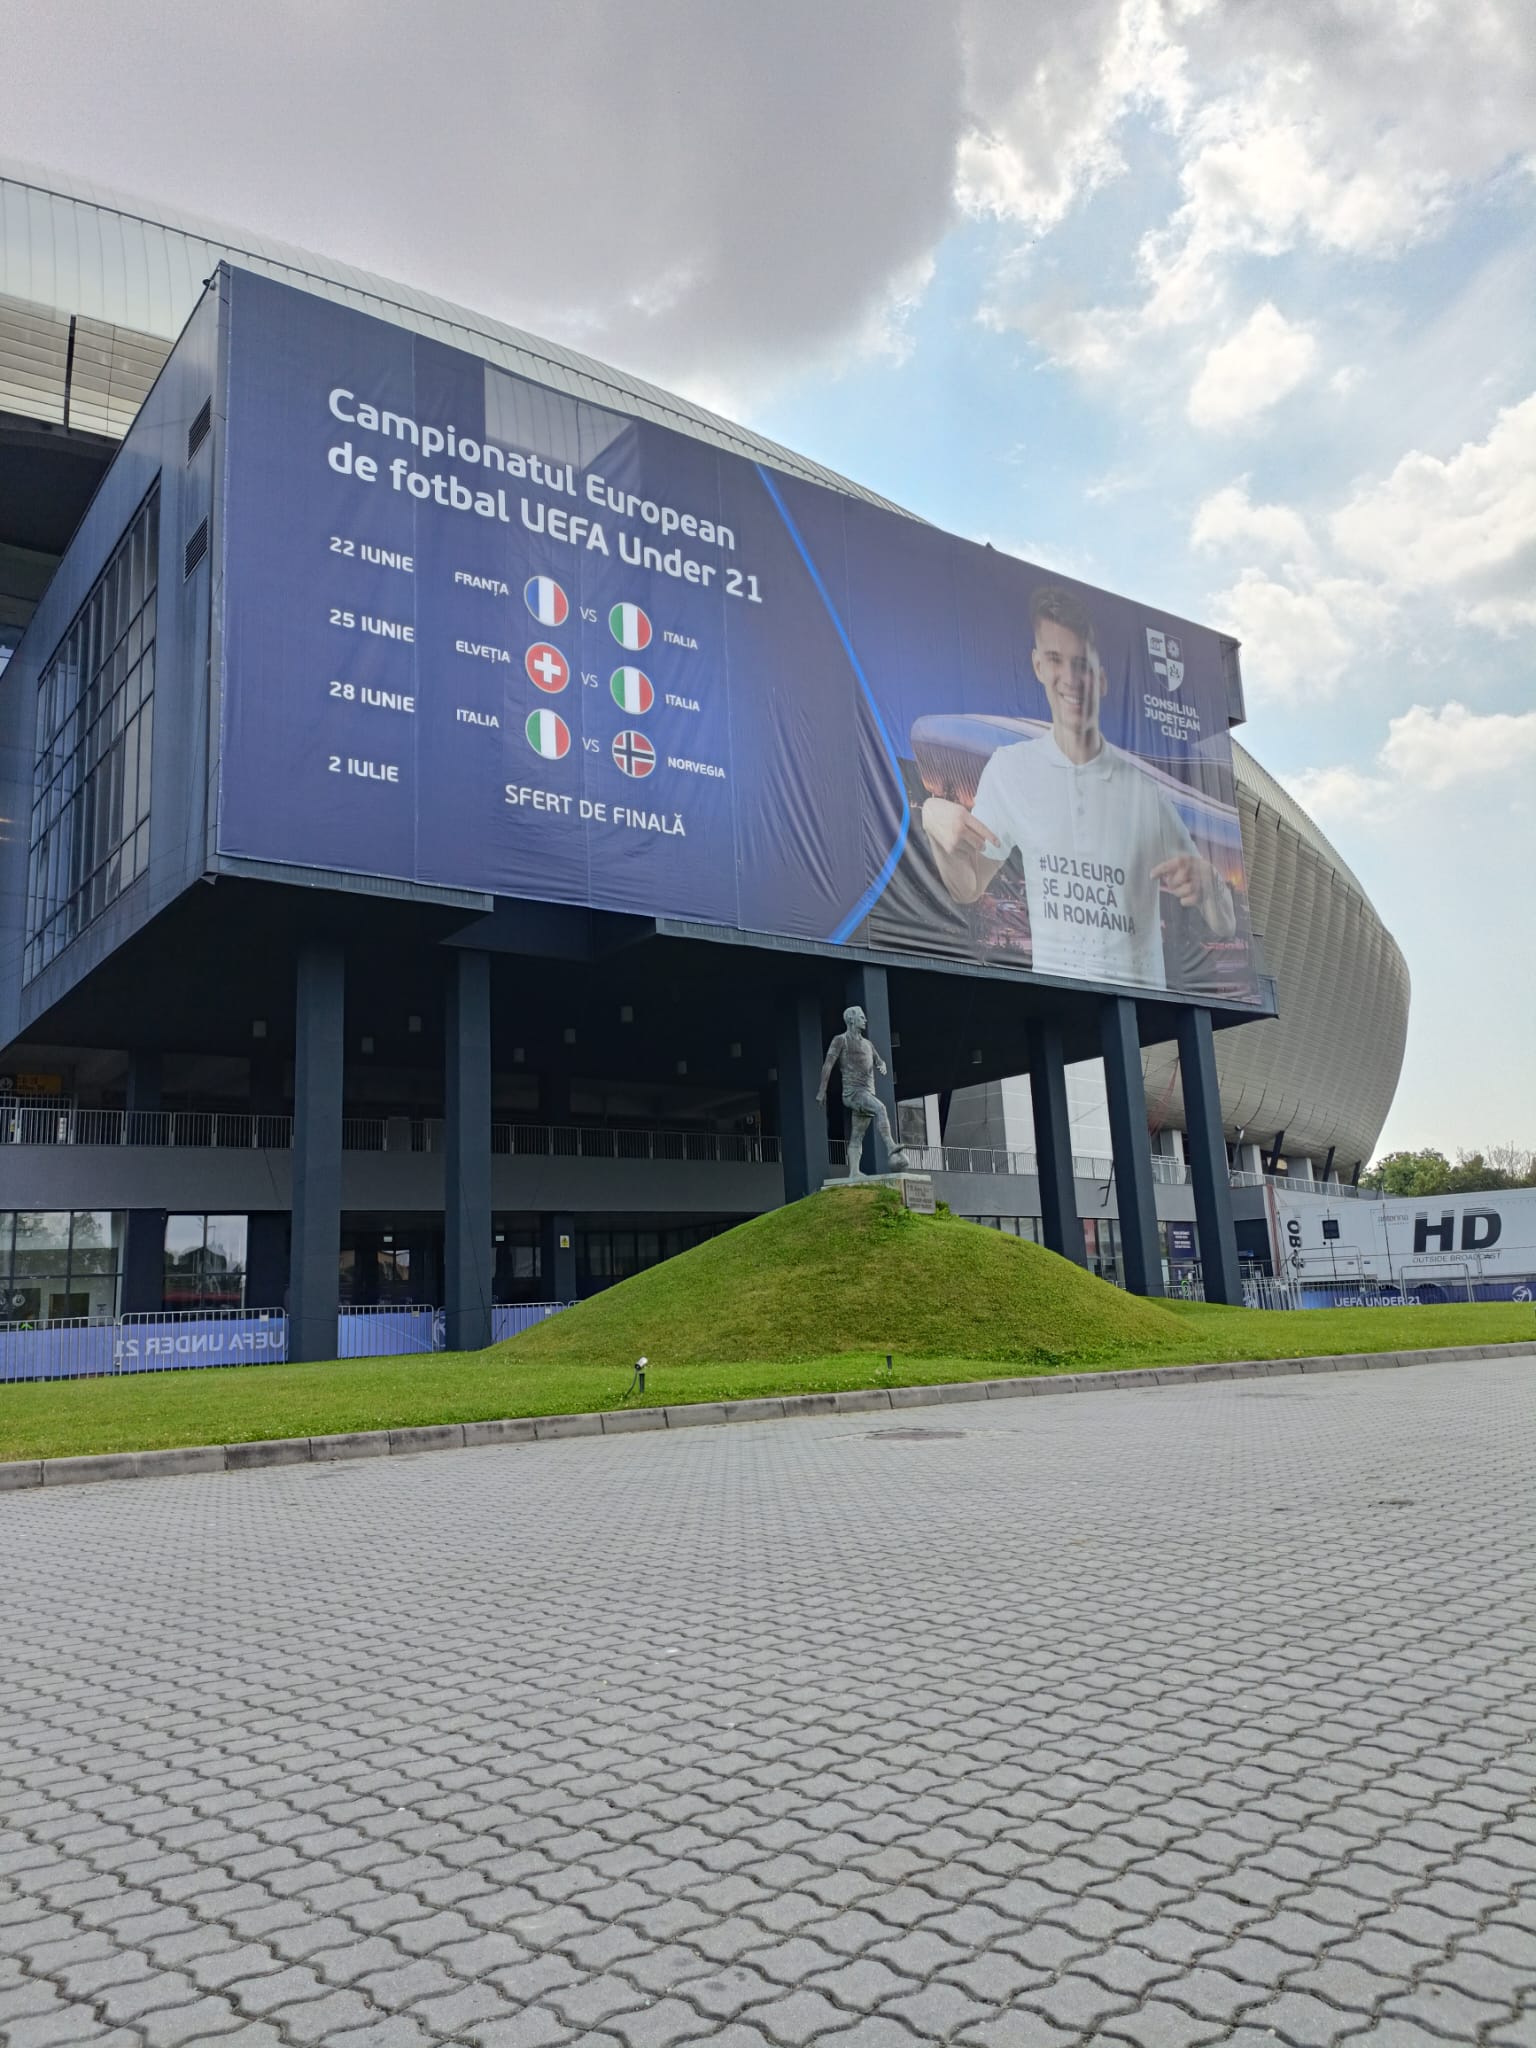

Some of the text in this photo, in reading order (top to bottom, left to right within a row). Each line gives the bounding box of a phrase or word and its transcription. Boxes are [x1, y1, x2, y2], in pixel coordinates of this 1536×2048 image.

[329, 388, 735, 550] Campionatul European
[328, 441, 763, 603] de fotbal UEFA Under 21
[329, 536, 414, 573] 22 IUNIE
[454, 571, 510, 596] FRANȚA
[329, 609, 415, 642] 25 IUNIE
[580, 606, 598, 623] VS
[455, 640, 511, 663] ELVEȚIA
[663, 631, 698, 650] ITALIA
[581, 671, 599, 688] VS
[329, 681, 415, 713] 28 IUNIE
[665, 693, 700, 712] ITALIA
[1143, 694, 1200, 719] CONSILIUL
[456, 708, 499, 728] ITALIA
[582, 736, 600, 753] VS
[1161, 725, 1188, 740] CLUJ
[328, 756, 399, 782] 2 IULIE
[667, 756, 726, 779] NORVEGIA
[505, 784, 686, 836] SFERT DE FINALĂ
[1040, 854, 1125, 886] #U21EURO
[1043, 877, 1118, 908] SE JOACĂ
[1043, 896, 1136, 935] ÎN ROMÂNIA
[1413, 1207, 1502, 1253] HD
[1412, 1253, 1449, 1264] OUTSIDE
[1334, 1295, 1422, 1308] UEFA UNDER 21
